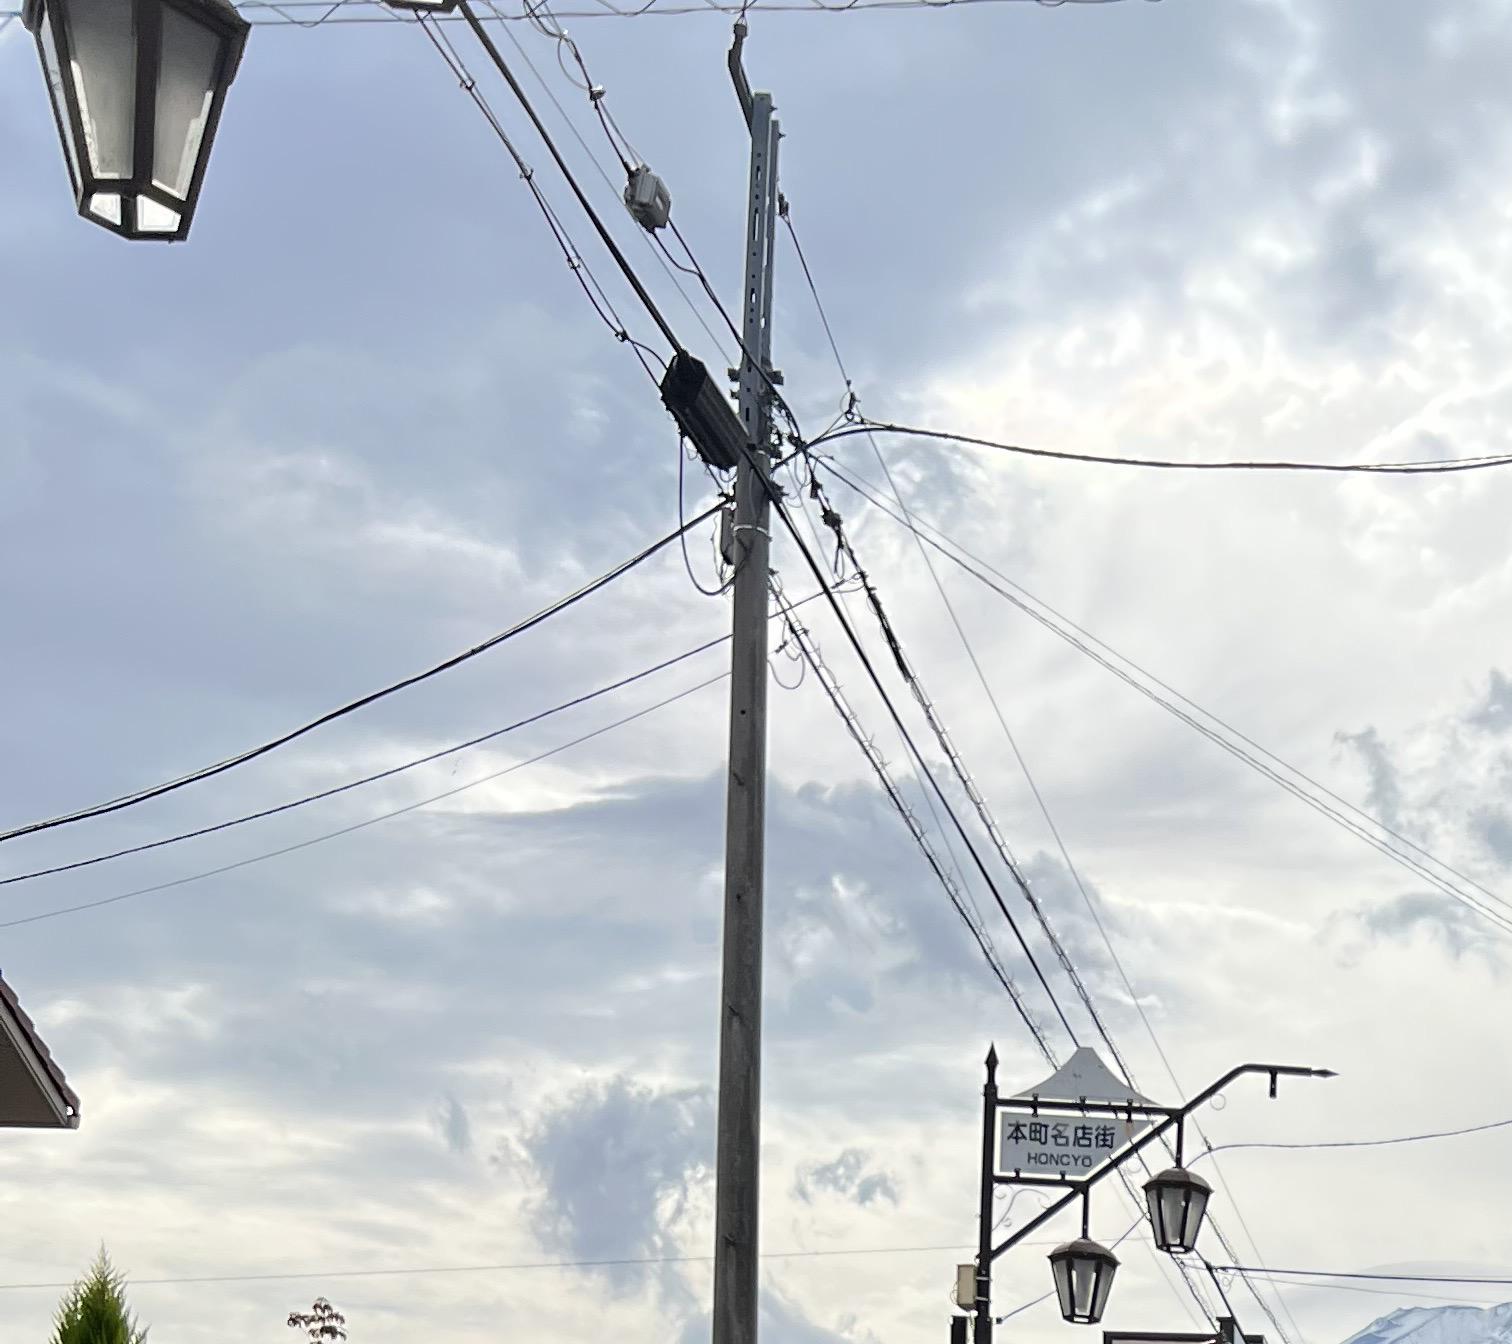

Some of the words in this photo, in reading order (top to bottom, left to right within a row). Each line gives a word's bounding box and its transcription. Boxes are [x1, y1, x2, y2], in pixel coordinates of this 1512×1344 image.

[1007, 1120, 1116, 1149] 本町名店街
